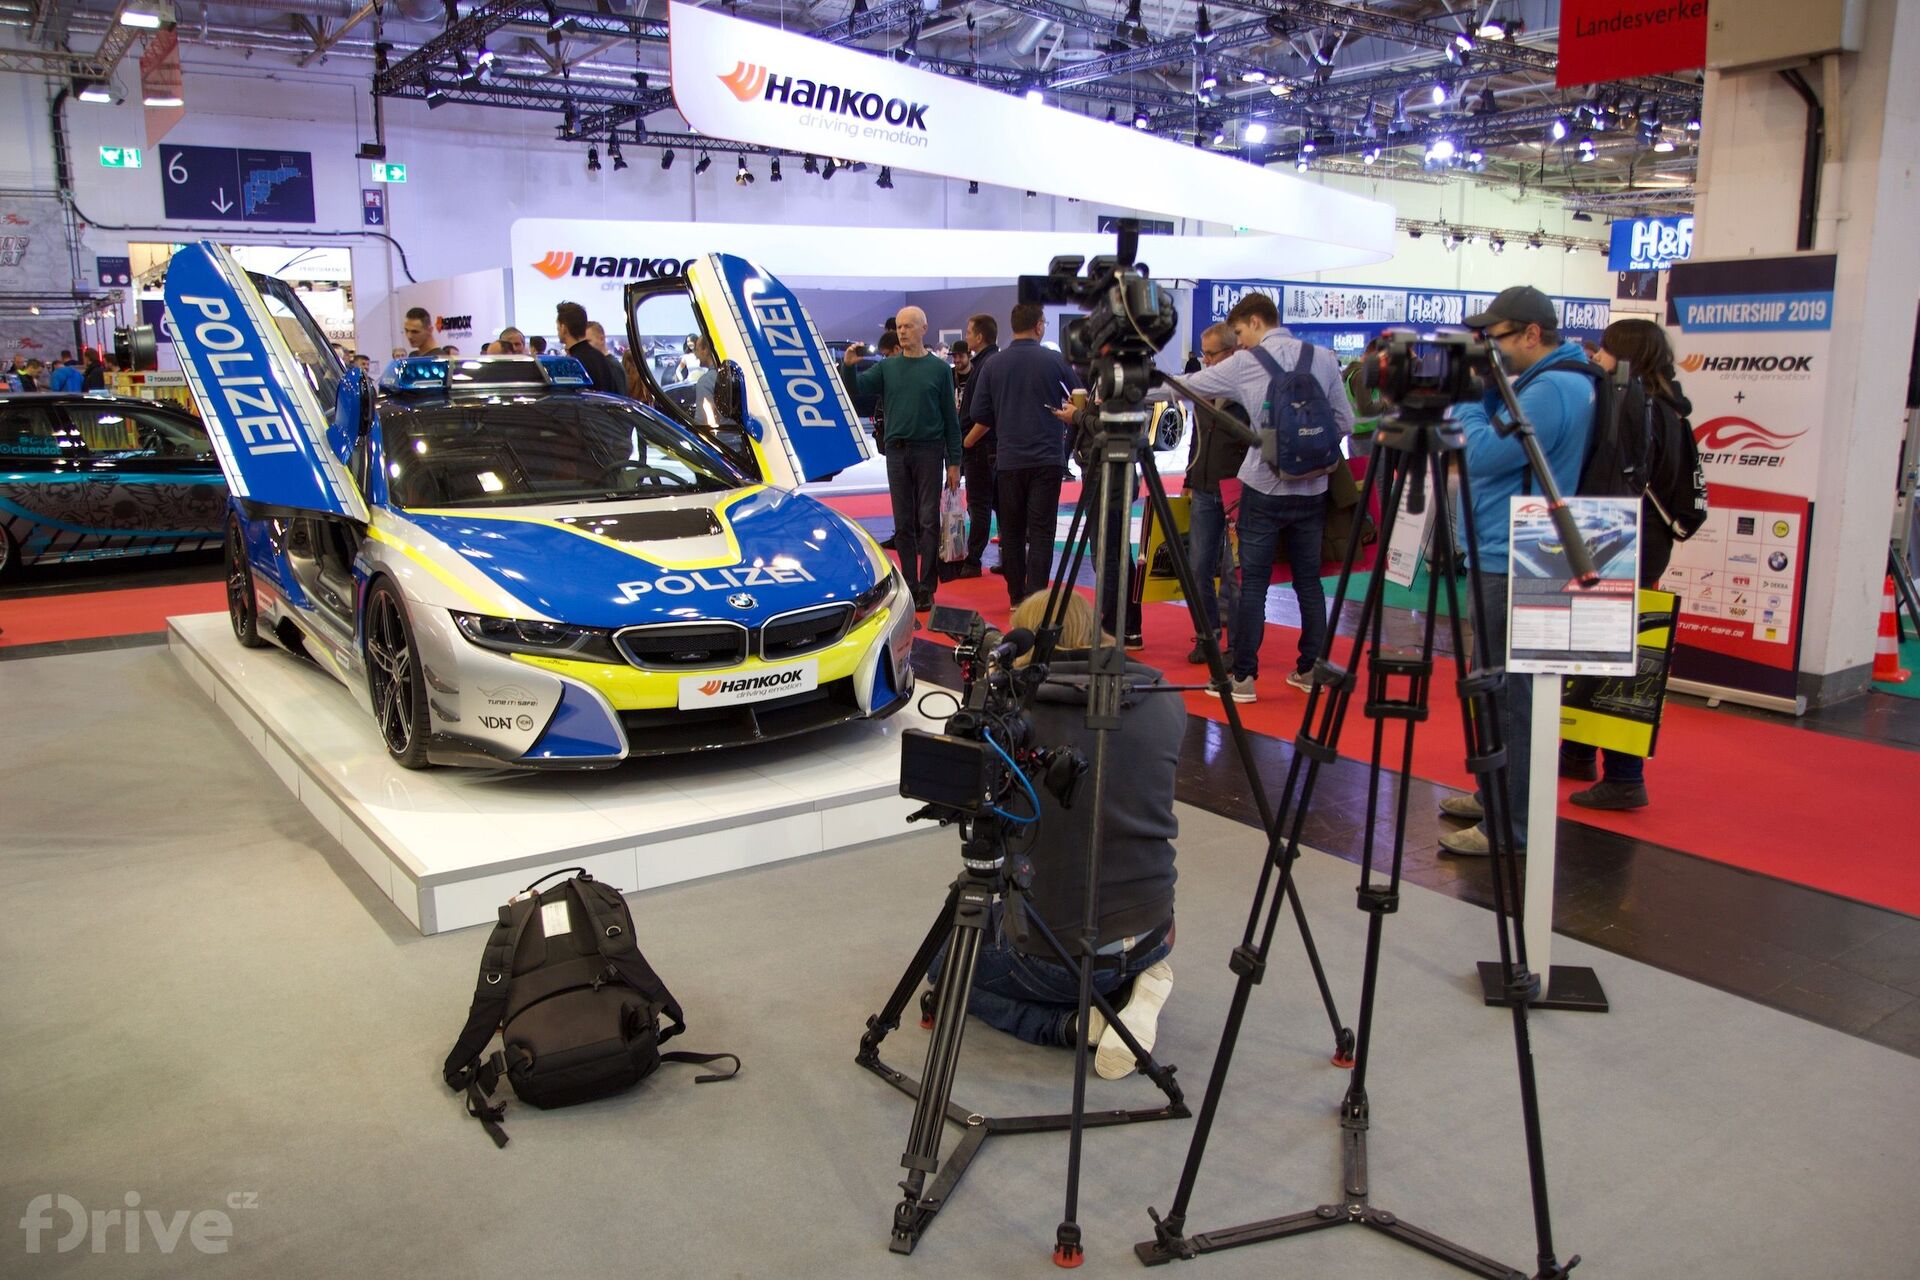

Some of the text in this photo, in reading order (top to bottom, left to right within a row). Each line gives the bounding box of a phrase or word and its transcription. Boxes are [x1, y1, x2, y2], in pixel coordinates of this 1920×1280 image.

[1576, 0, 1708, 37] Landesverke
[799, 113, 929, 148] driving emotion
[168, 152, 189, 184] 6
[572, 256, 698, 278] HANKO
[1688, 301, 1826, 324] PARTNERSHIP 2019
[180, 295, 298, 456] POLIZEI
[751, 298, 836, 427] POLIZEI
[1719, 372, 1811, 382] driving emotion
[617, 566, 816, 601] POLIZEI
[736, 682, 803, 699] driving emotion
[478, 715, 512, 730] VDAT
